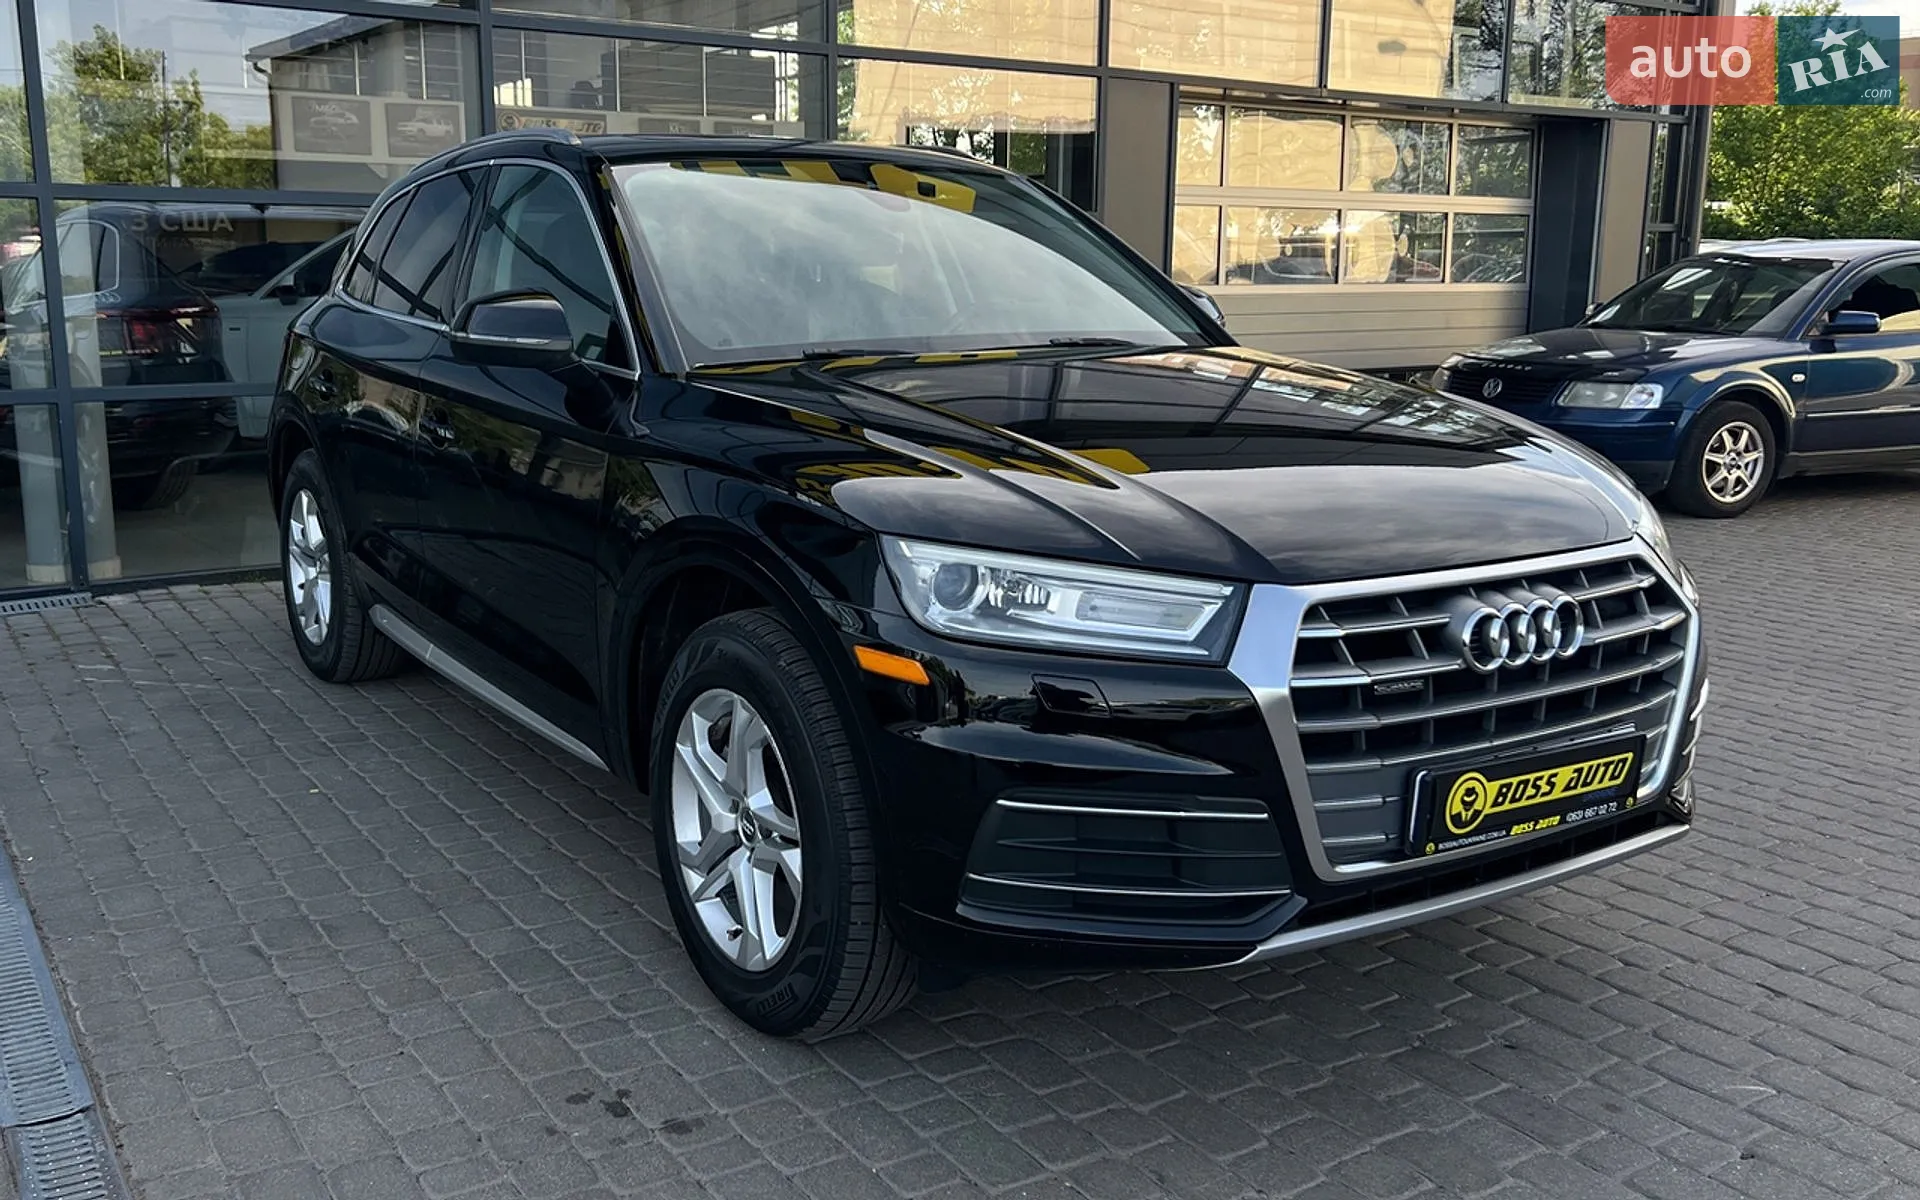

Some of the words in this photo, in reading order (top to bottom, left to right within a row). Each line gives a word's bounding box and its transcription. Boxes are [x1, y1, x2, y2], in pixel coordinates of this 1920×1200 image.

[159, 210, 234, 232] США
[1491, 771, 1560, 809] BOSS
[1560, 757, 1630, 793] AUTO
